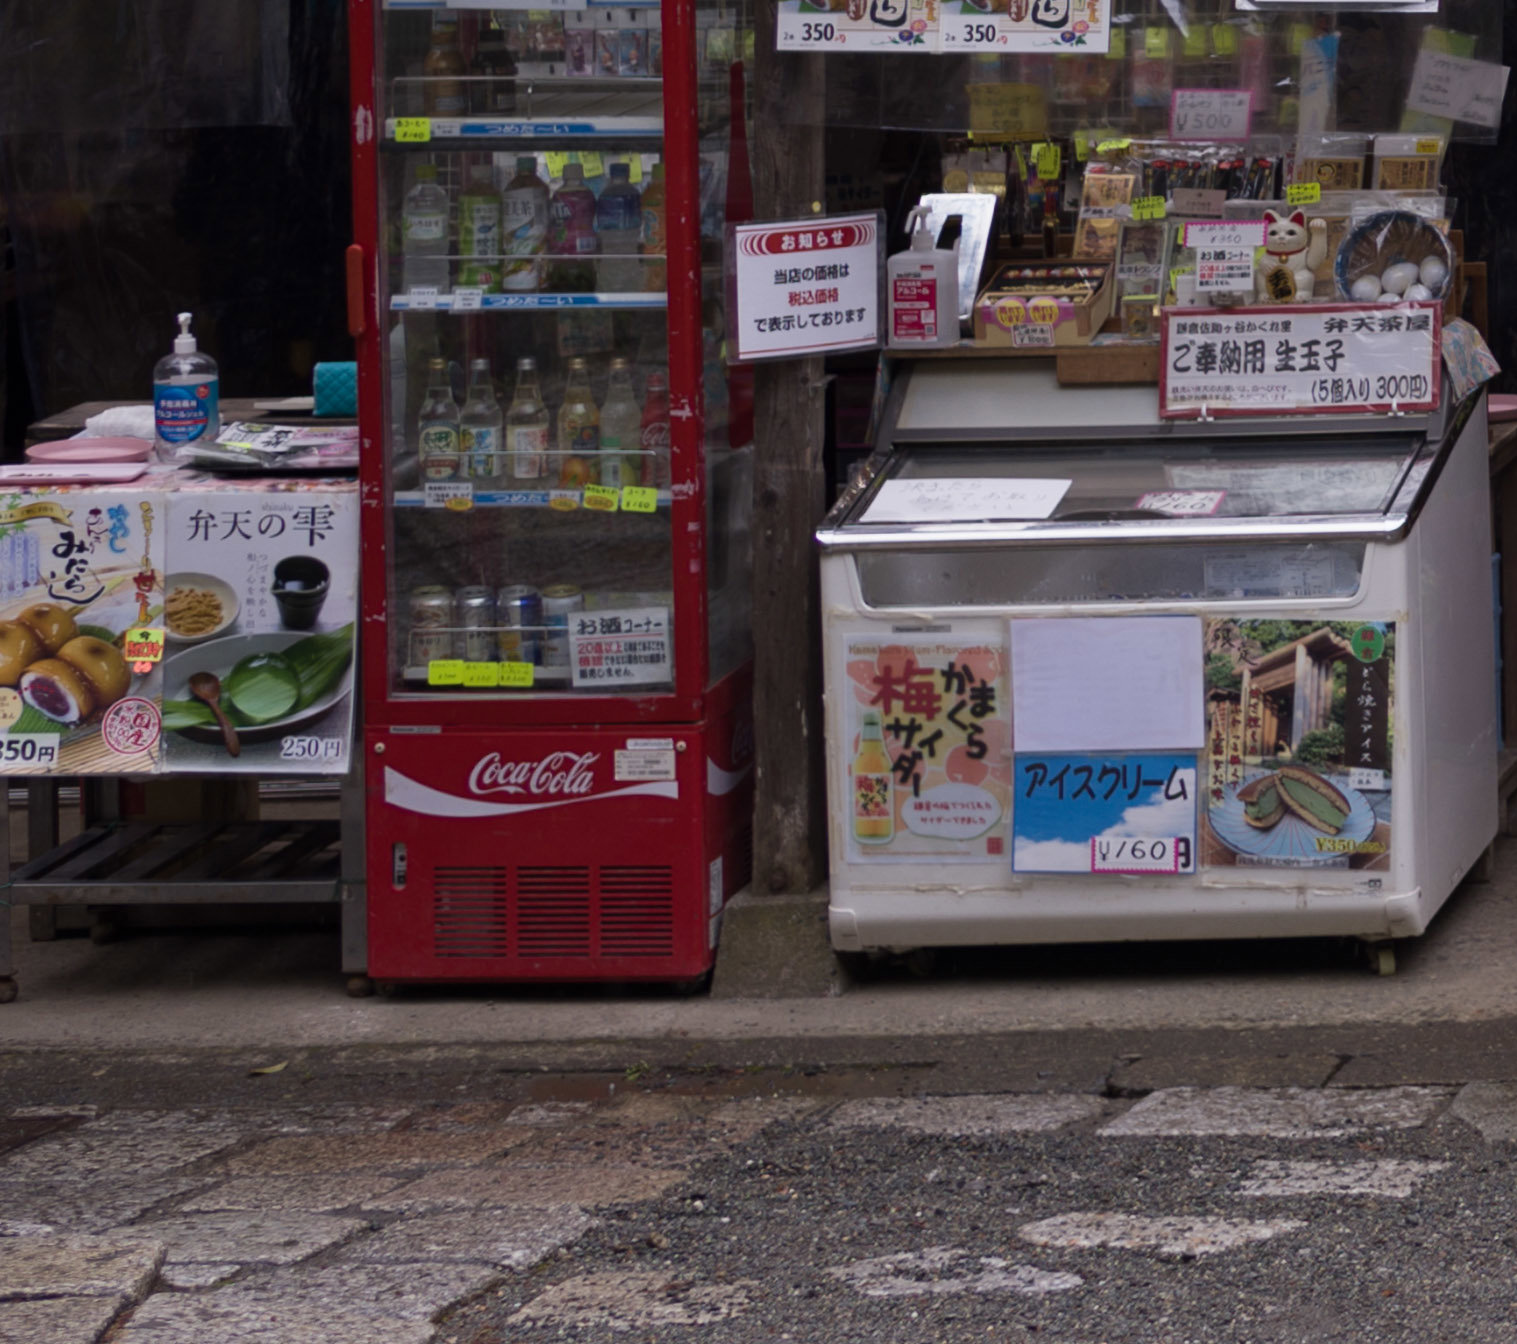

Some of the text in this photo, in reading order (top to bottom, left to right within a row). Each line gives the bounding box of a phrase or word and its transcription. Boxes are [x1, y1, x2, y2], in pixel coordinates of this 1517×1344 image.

[780, 229, 845, 250] お知らせ
[773, 263, 850, 285] 当店の価格は
[788, 288, 839, 308] 税込価格
[754, 307, 867, 333] で表示しております
[1323, 315, 1430, 333] 弁天茶屋
[1171, 340, 1346, 375] ご奉納用 生玉子
[1310, 374, 1429, 403] (5個入り 300円)
[187, 503, 336, 547] 弁天の雫
[576, 616, 663, 637] お酒コーナー
[870, 659, 942, 720] 梅
[280, 737, 341, 759] 250円
[885, 717, 945, 797] サイダー
[468, 750, 600, 796] Coca-Cola
[1022, 761, 1189, 802] アイスクリーム
[1097, 840, 1168, 862] ¥160
[1315, 836, 1357, 852] ¥350
